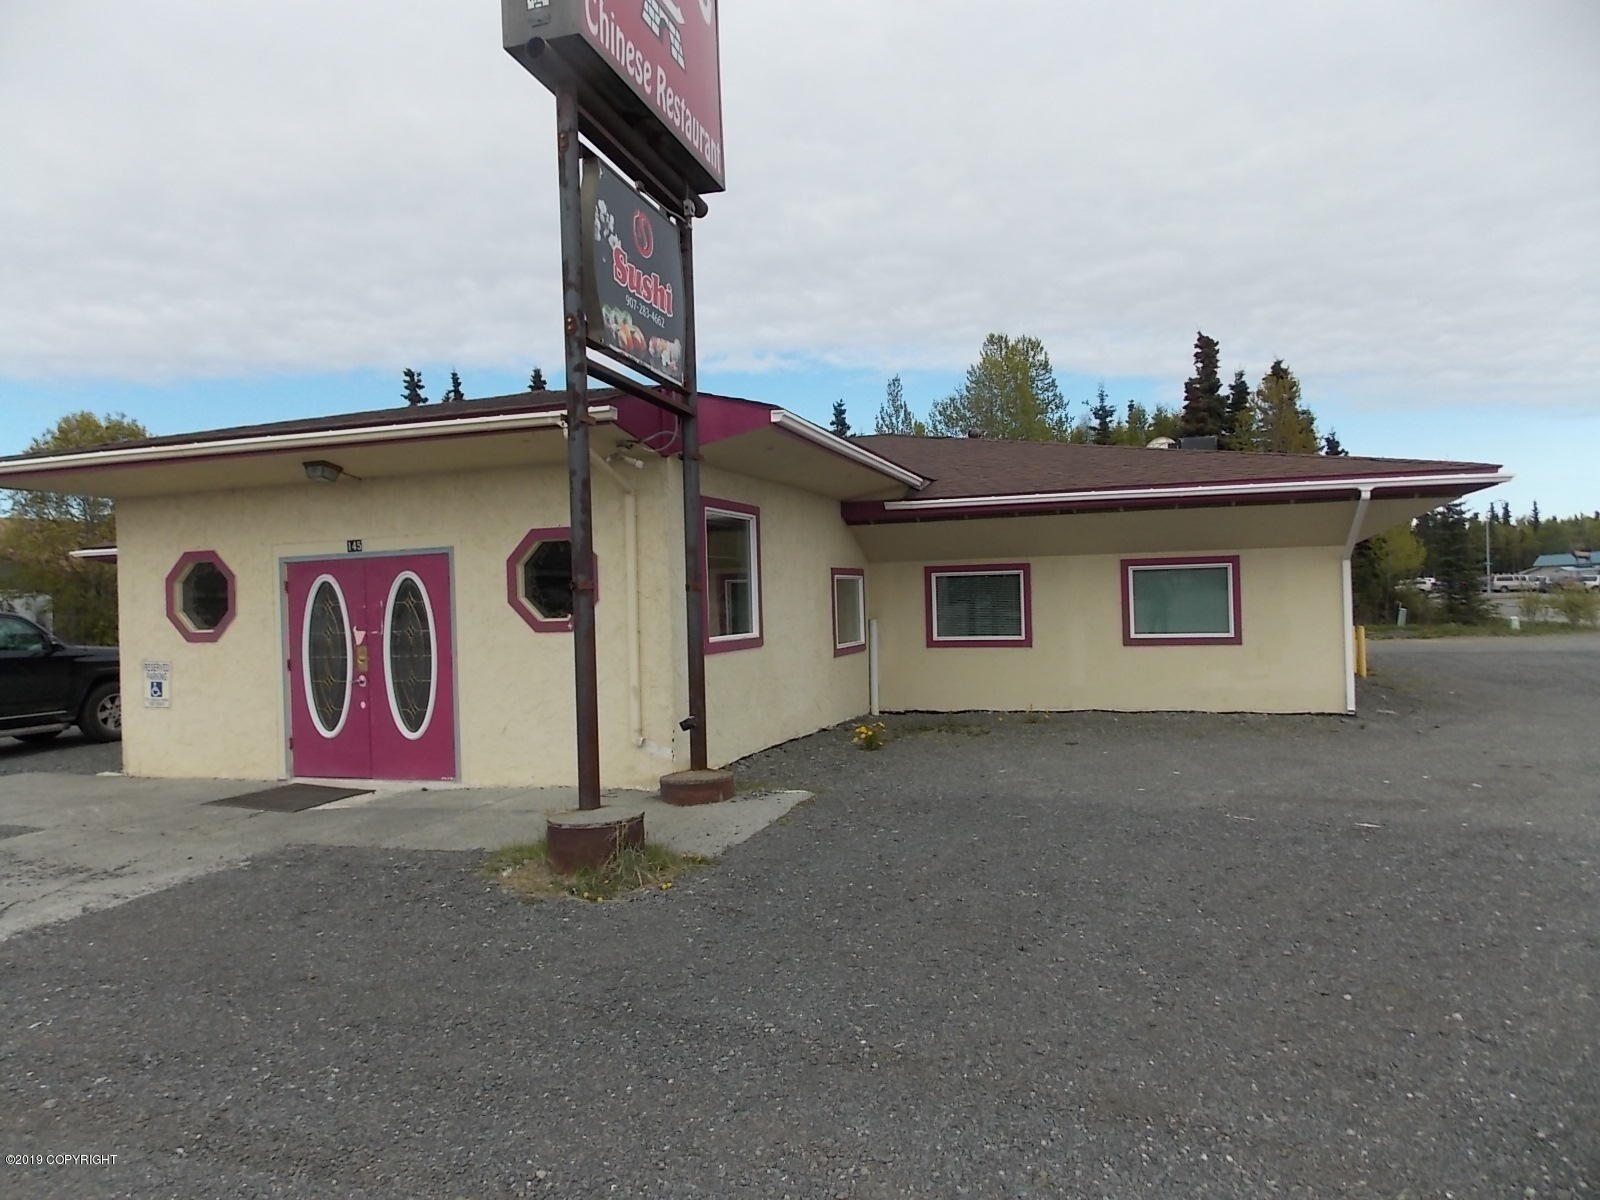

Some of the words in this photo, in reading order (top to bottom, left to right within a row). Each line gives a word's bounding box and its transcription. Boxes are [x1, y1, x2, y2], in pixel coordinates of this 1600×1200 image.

[584, 0, 652, 94] Chinese
[656, 65, 722, 174] Restaurant
[613, 246, 673, 317] Sushi
[347, 540, 362, 552] 145
